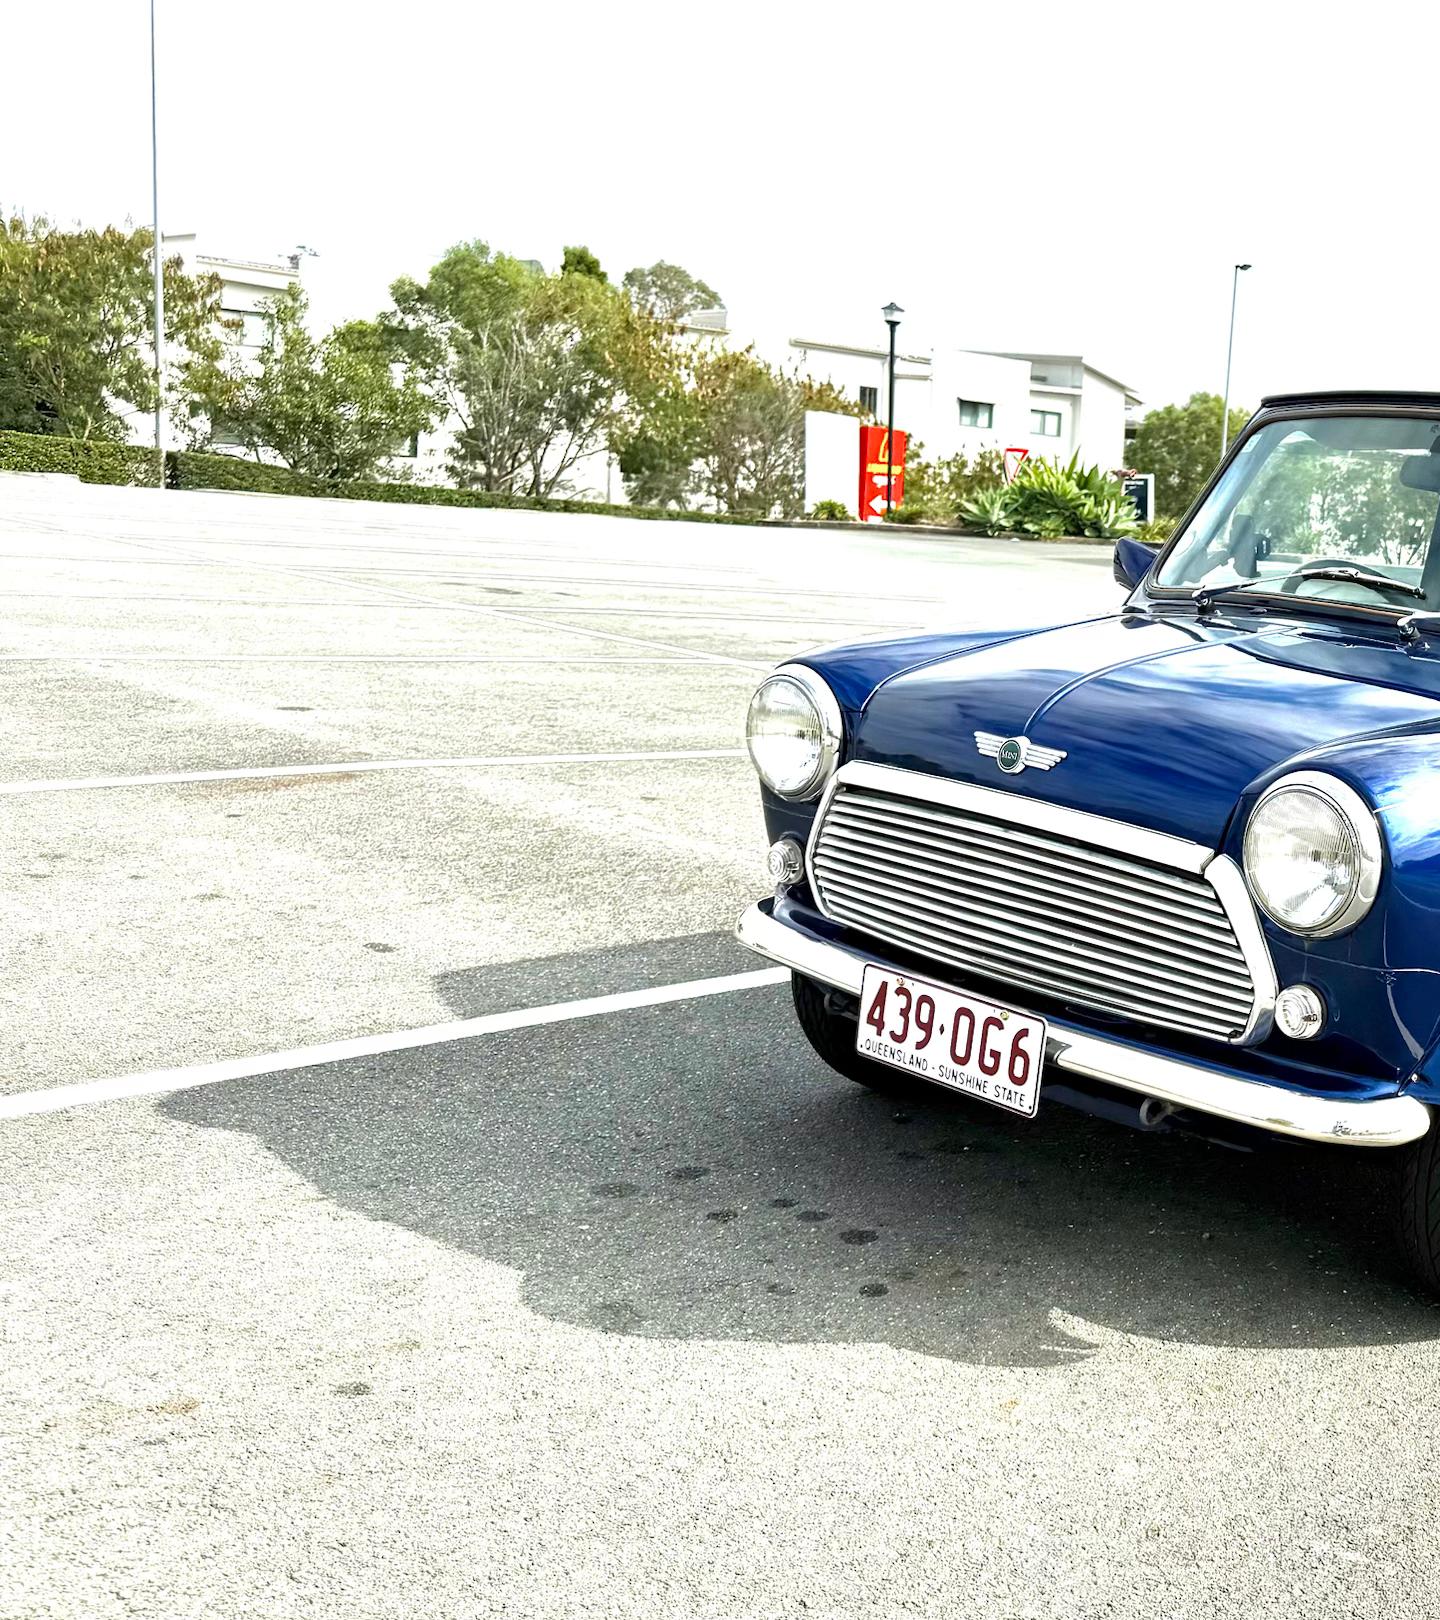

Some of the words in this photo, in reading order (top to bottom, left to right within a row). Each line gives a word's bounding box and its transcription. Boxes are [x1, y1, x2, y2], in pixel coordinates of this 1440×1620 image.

[1001, 750, 1018, 760] MINI
[864, 1038, 928, 1071] QUEENSLAND
[938, 1065, 989, 1094] SUNSHINE
[994, 1085, 1026, 1108] STATE
